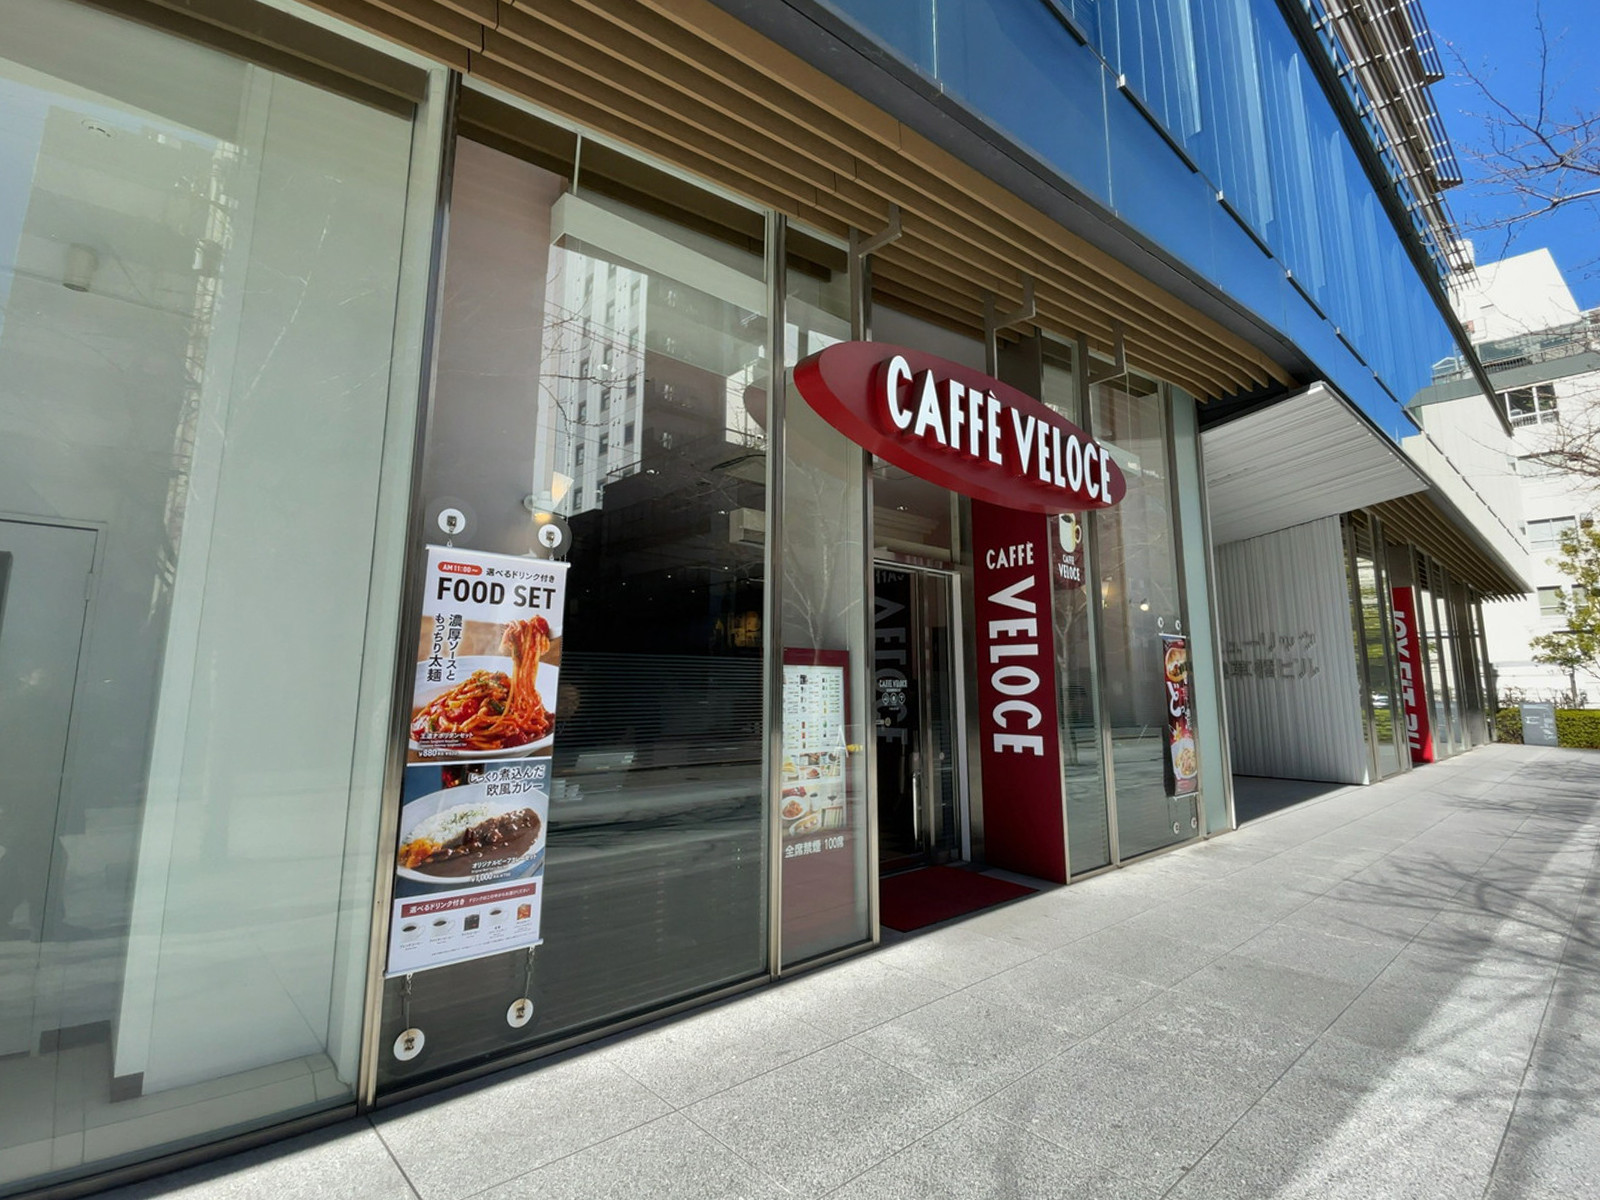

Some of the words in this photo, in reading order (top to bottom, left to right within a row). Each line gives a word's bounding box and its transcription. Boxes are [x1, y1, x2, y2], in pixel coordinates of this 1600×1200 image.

[887, 355, 1002, 465] CAFFÈ
[1011, 407, 1112, 504] VELOCE
[986, 541, 1034, 570] CAFFÈ
[486, 567, 555, 583] 選べるドリンク付き
[1058, 563, 1081, 582] VELOCE
[437, 577, 505, 605] FOOD
[513, 585, 556, 609] SET
[427, 613, 445, 683] もっちり太麺
[446, 613, 463, 681] 濃厚ソースと
[987, 575, 1044, 756] VELOCE
[468, 765, 545, 784] じっくり煮込んだ
[486, 782, 544, 798] 欧風カレー
[409, 898, 465, 914] 選べるドリンク付き
